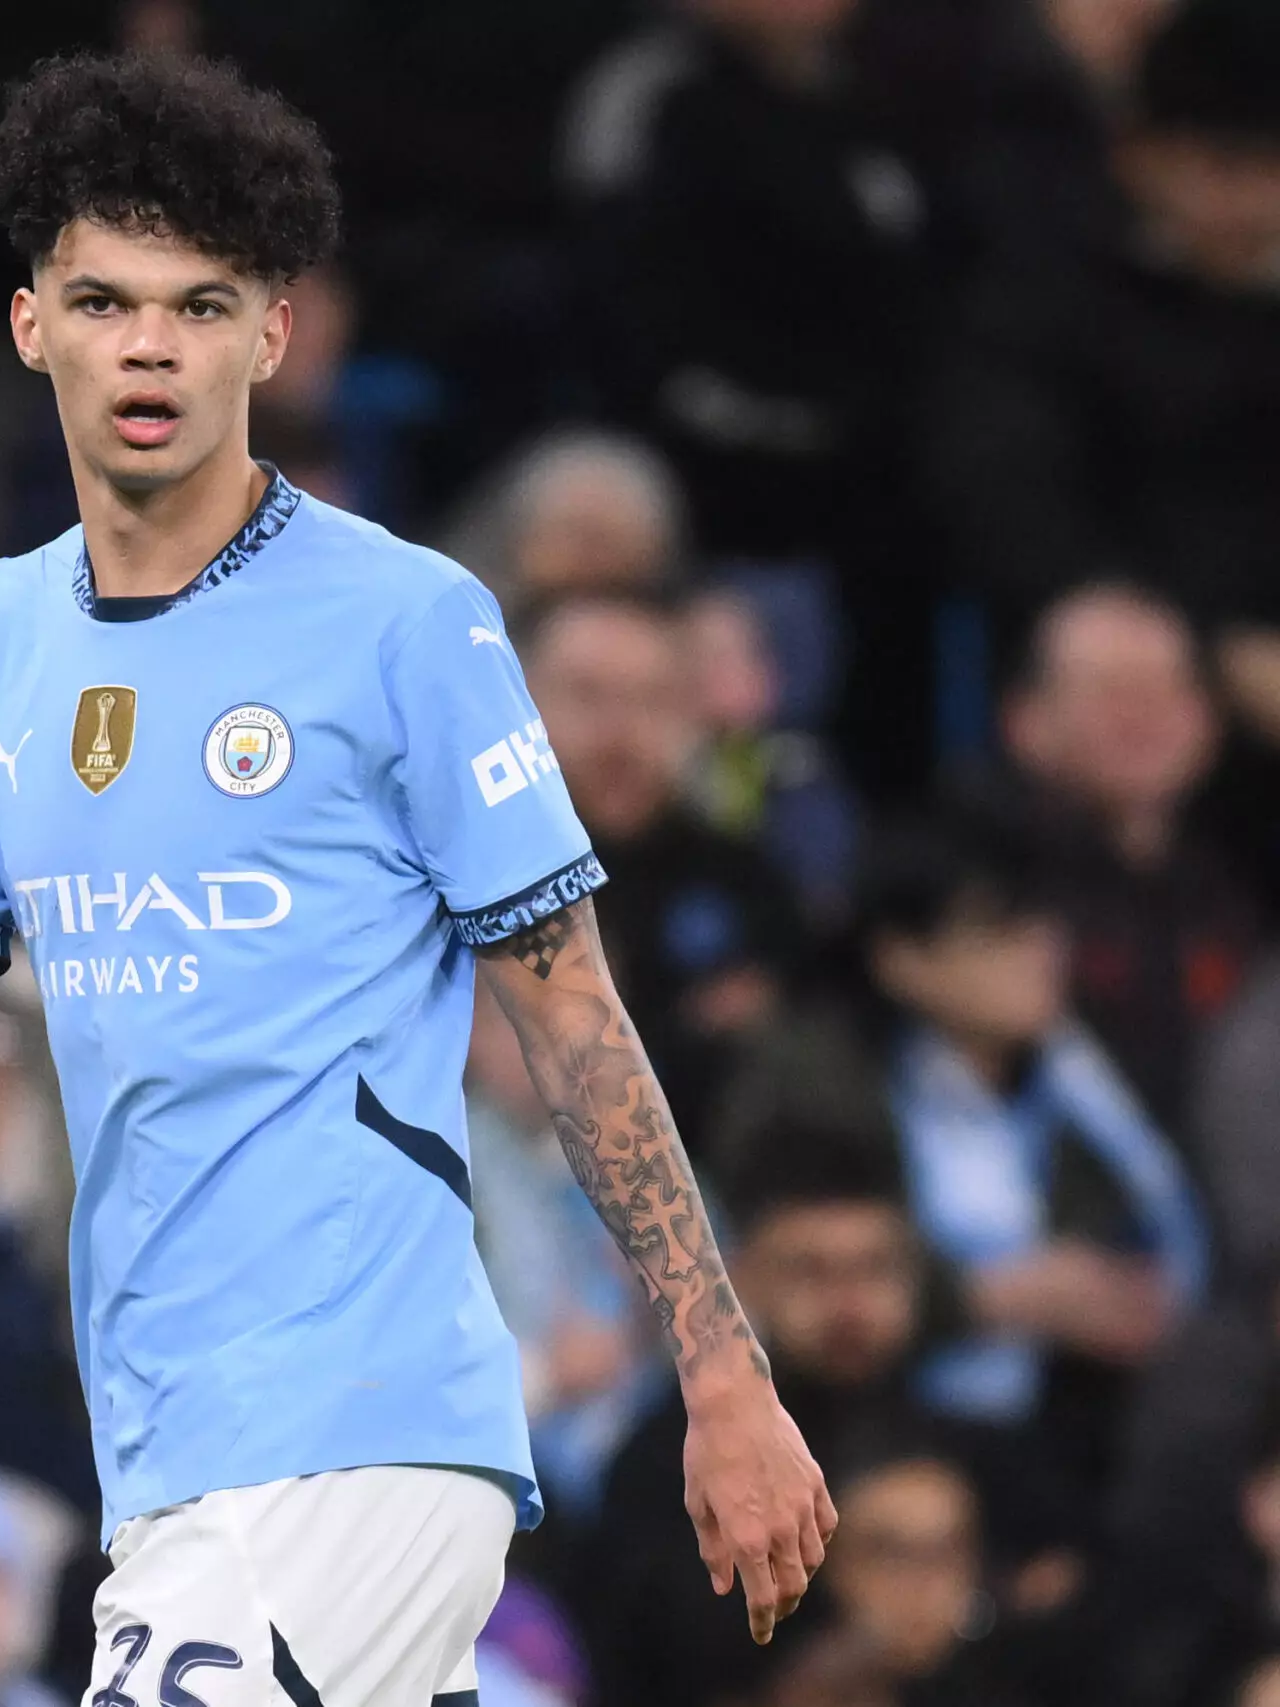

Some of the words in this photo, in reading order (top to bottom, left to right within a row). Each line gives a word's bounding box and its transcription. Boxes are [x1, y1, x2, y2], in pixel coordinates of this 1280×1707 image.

[215, 710, 285, 740] MANCHESTER
[86, 753, 114, 768] FIFA
[229, 782, 257, 792] CITY
[15, 871, 292, 937] TIHAD
